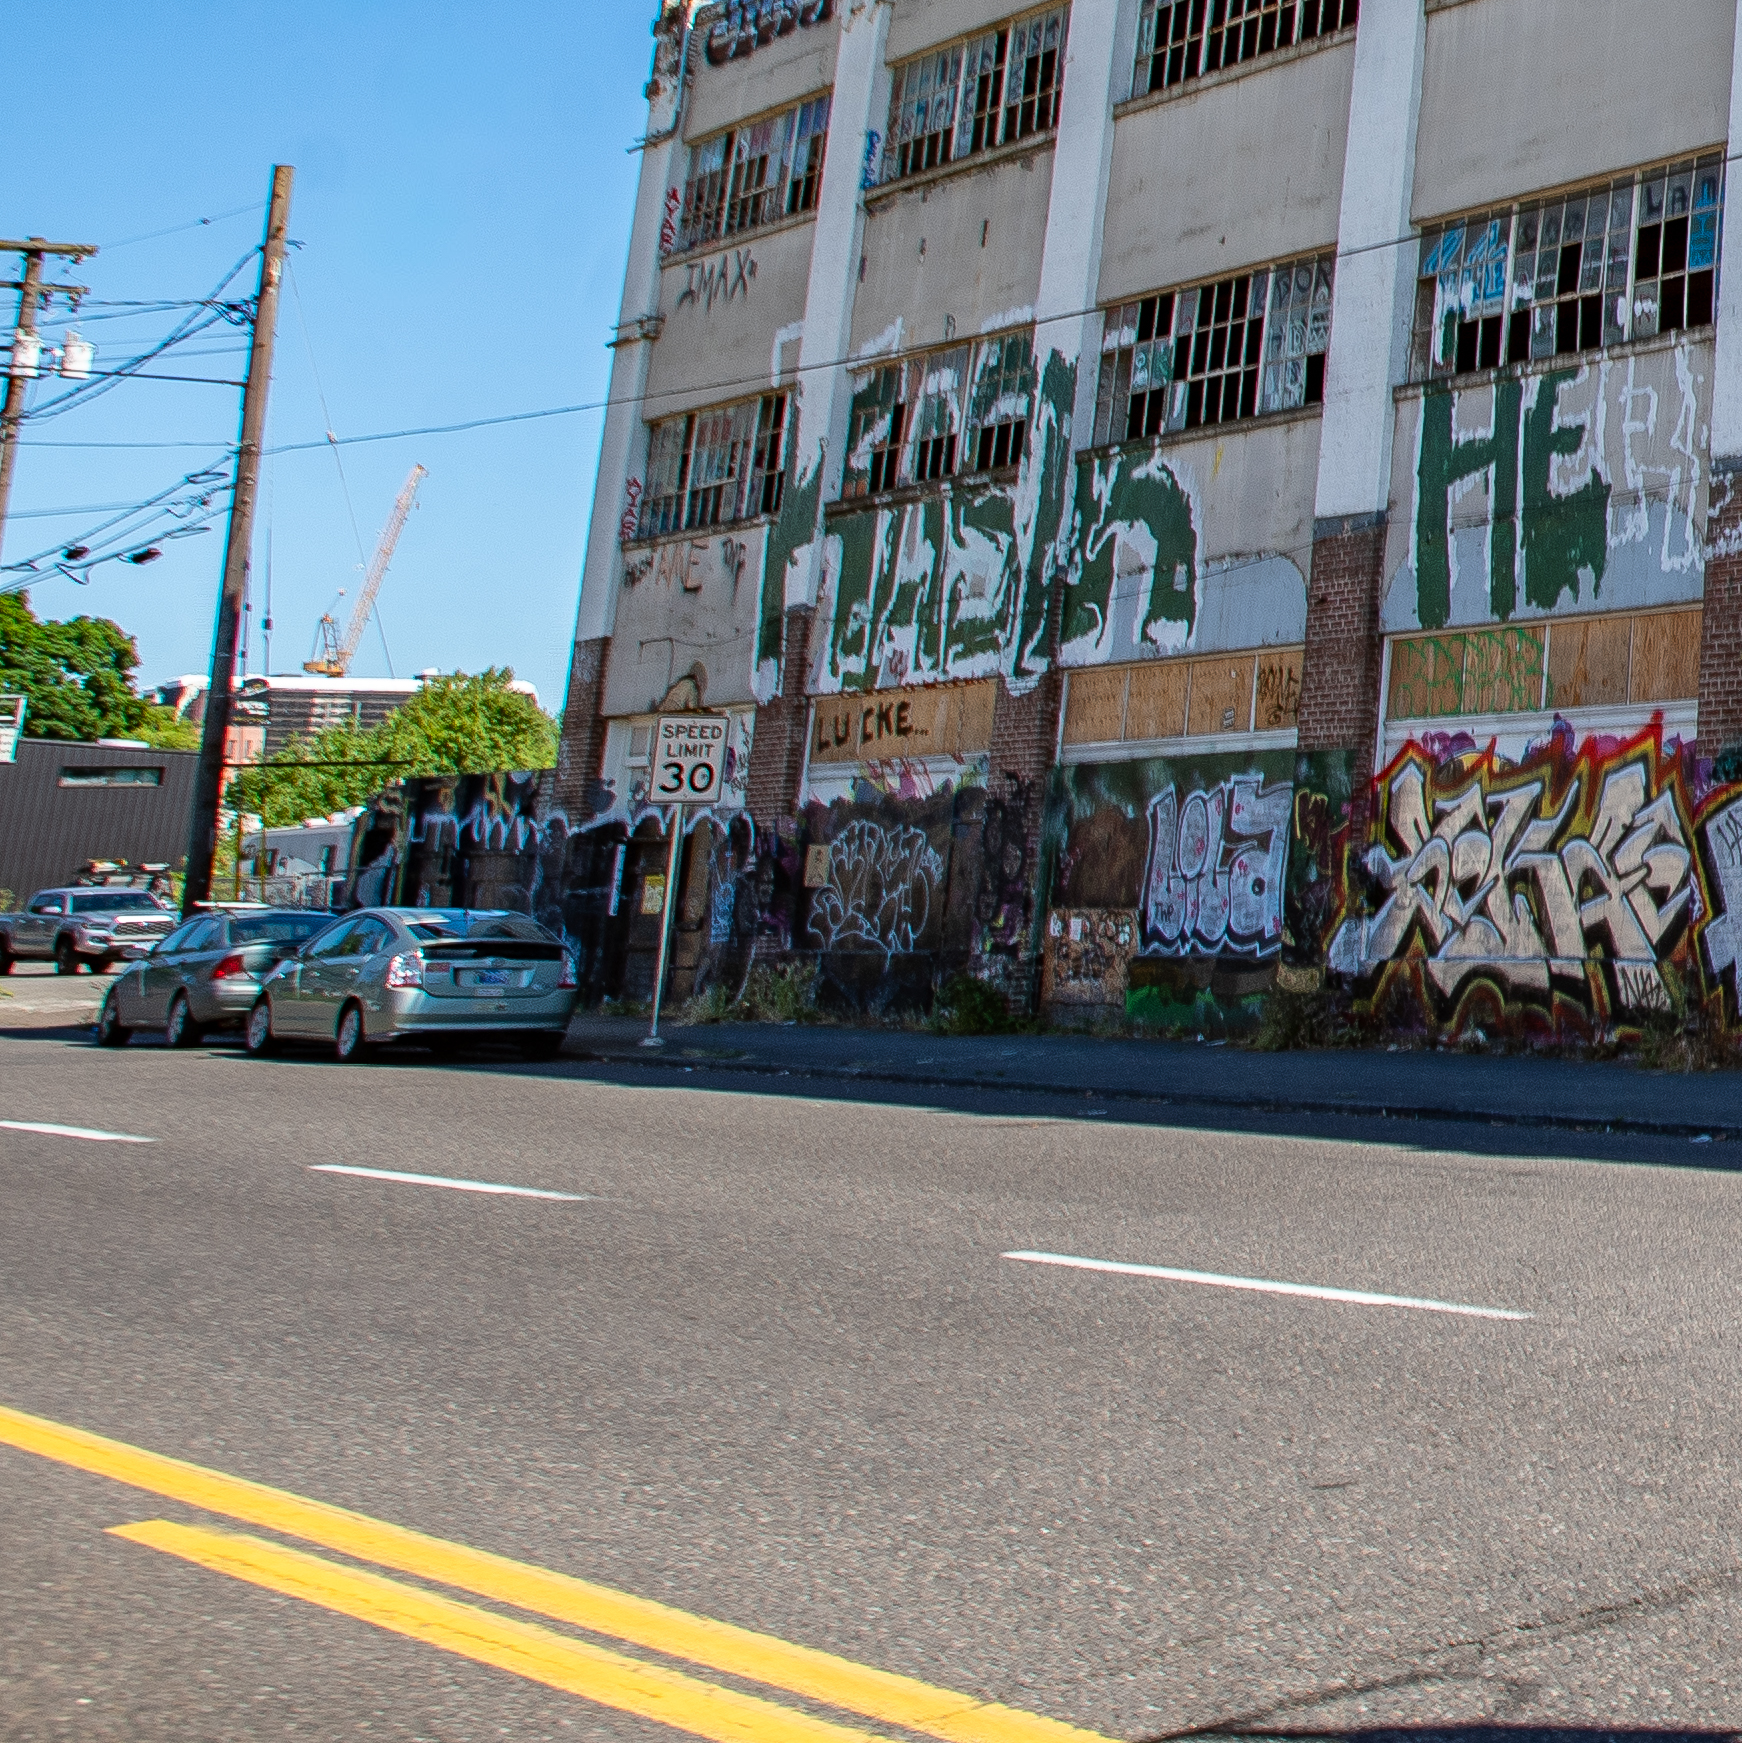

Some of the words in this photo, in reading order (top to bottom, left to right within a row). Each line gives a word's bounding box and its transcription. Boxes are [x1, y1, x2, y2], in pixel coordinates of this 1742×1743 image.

[662, 724, 723, 740] SPEED
[666, 743, 715, 758] LIMIT
[659, 761, 716, 794] 30
